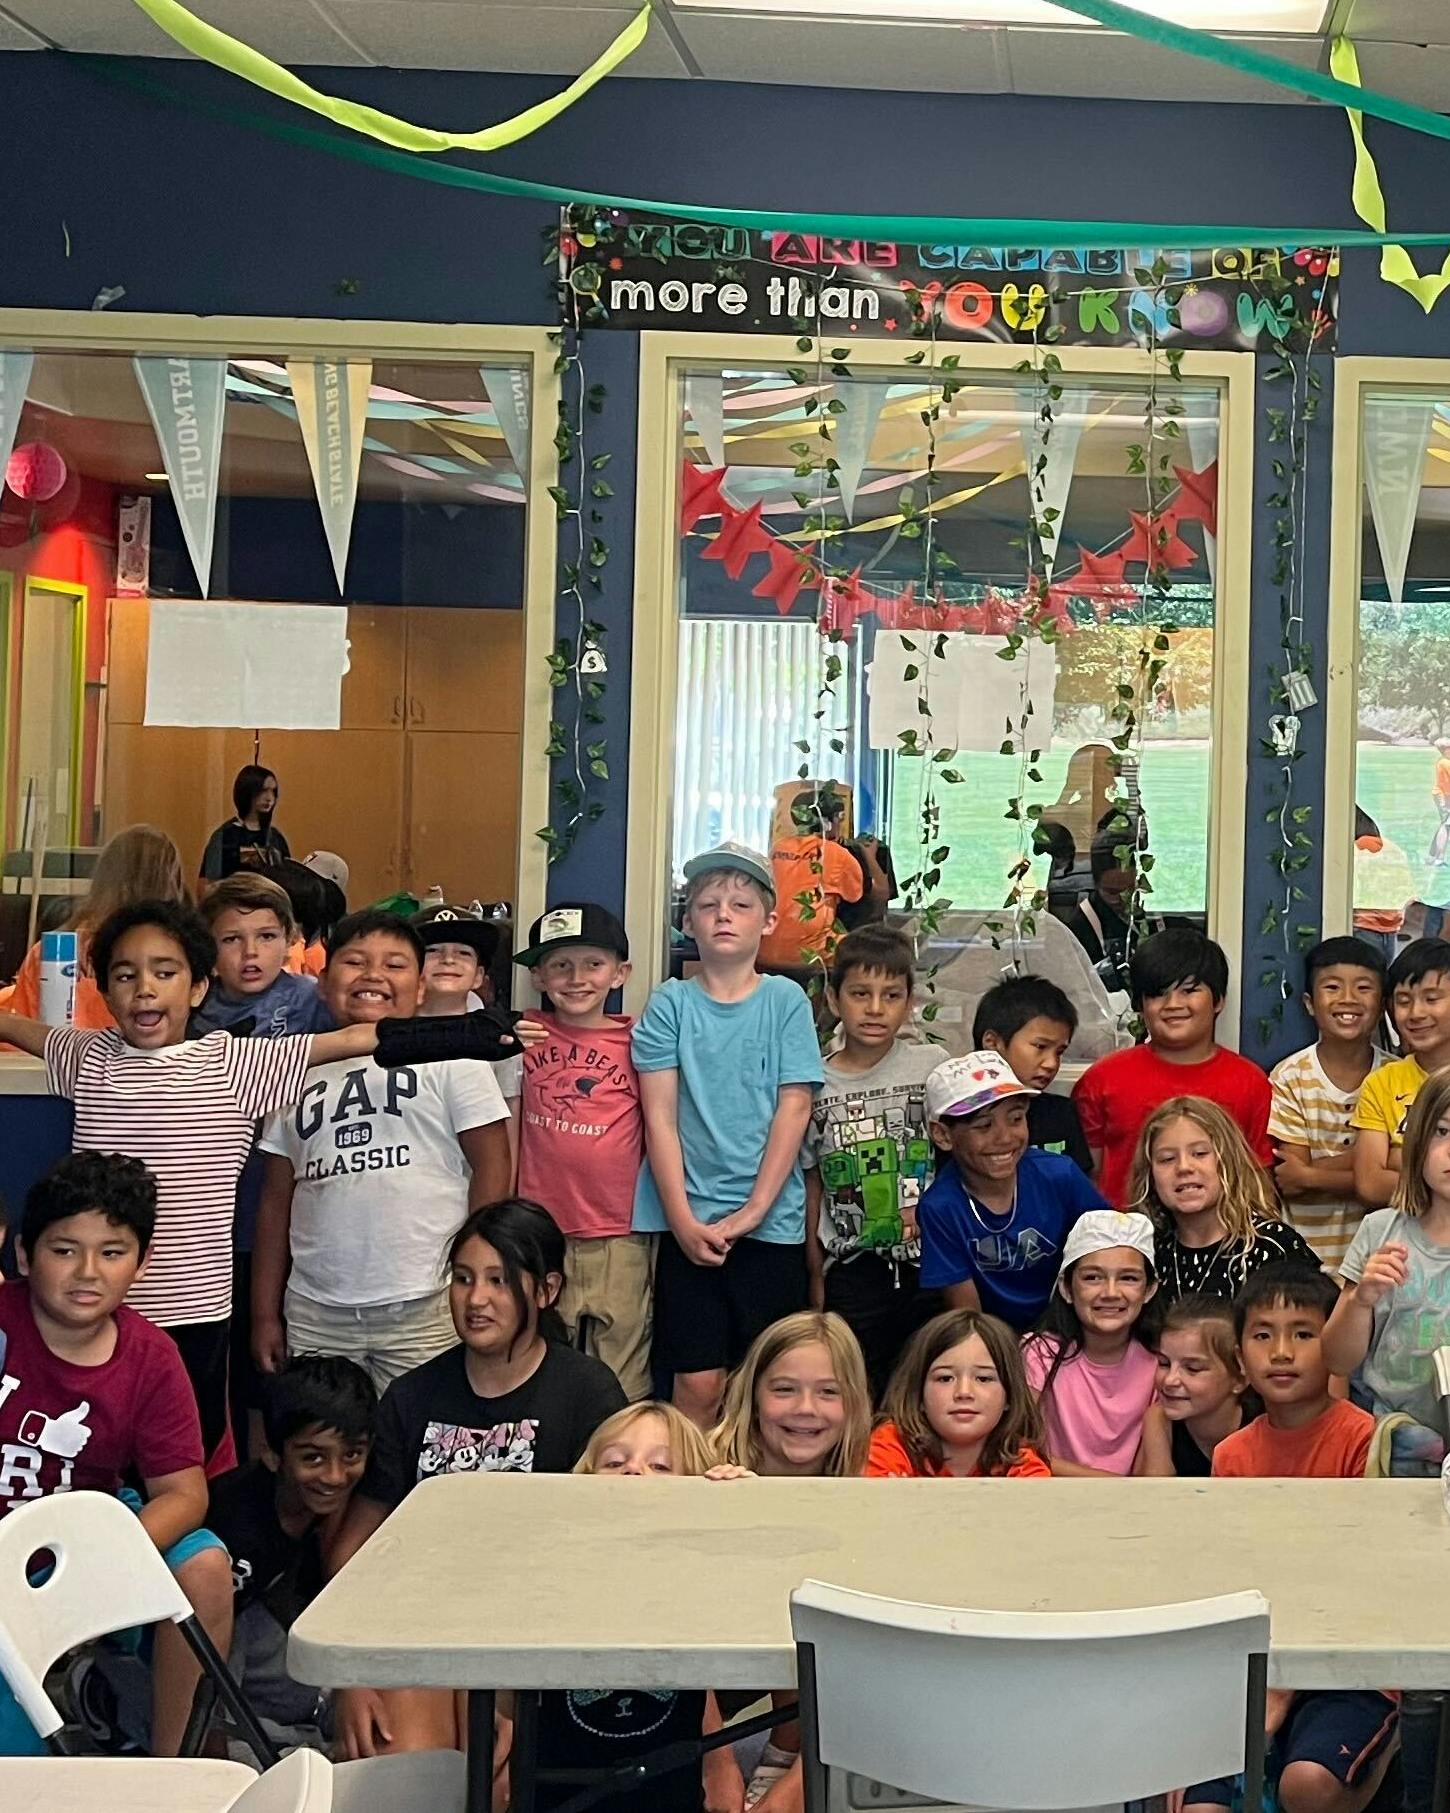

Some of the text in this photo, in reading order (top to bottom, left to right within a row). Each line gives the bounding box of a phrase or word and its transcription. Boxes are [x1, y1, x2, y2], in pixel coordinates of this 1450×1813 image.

[770, 231, 899, 267] ARE
[610, 279, 748, 315] more
[766, 276, 880, 320] than
[523, 1046, 561, 1075] LIKE
[567, 1044, 577, 1061] A
[296, 1067, 418, 1141] GAP
[555, 1119, 568, 1132] TO
[571, 1124, 610, 1136] COAST
[306, 1144, 411, 1180] CLASSIC
